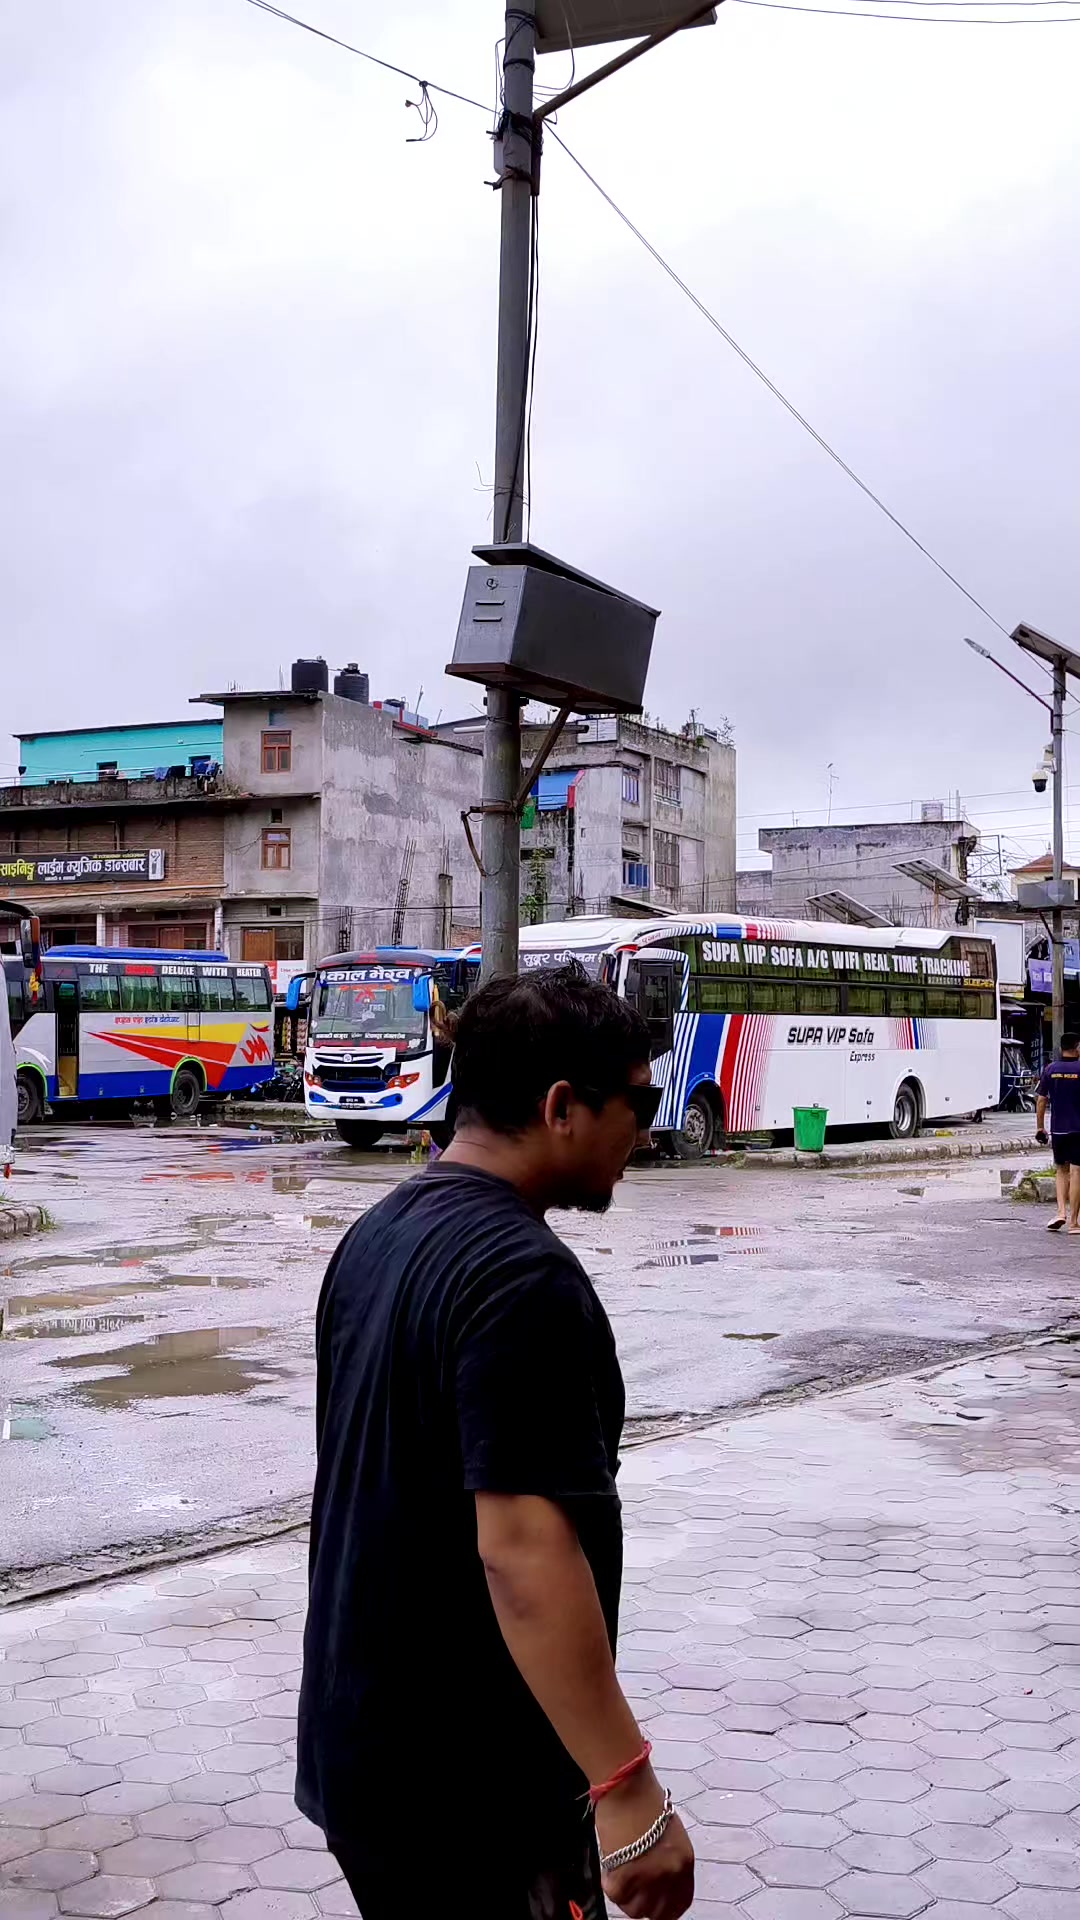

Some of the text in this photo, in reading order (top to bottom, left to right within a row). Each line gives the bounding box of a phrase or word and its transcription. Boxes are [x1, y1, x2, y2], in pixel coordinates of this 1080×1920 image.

[702, 940, 971, 977] SUPA VIP SOFA A/C WIFI REAL TIME TRACKING
[89, 963, 109, 974] THE
[162, 965, 195, 976] DELUXE
[202, 966, 228, 977] WITH
[236, 967, 262, 977] HEATER
[327, 965, 412, 983] काल भैरव
[787, 1026, 875, 1044] SUPA VIP Sofa
[849, 1051, 875, 1063] Express
